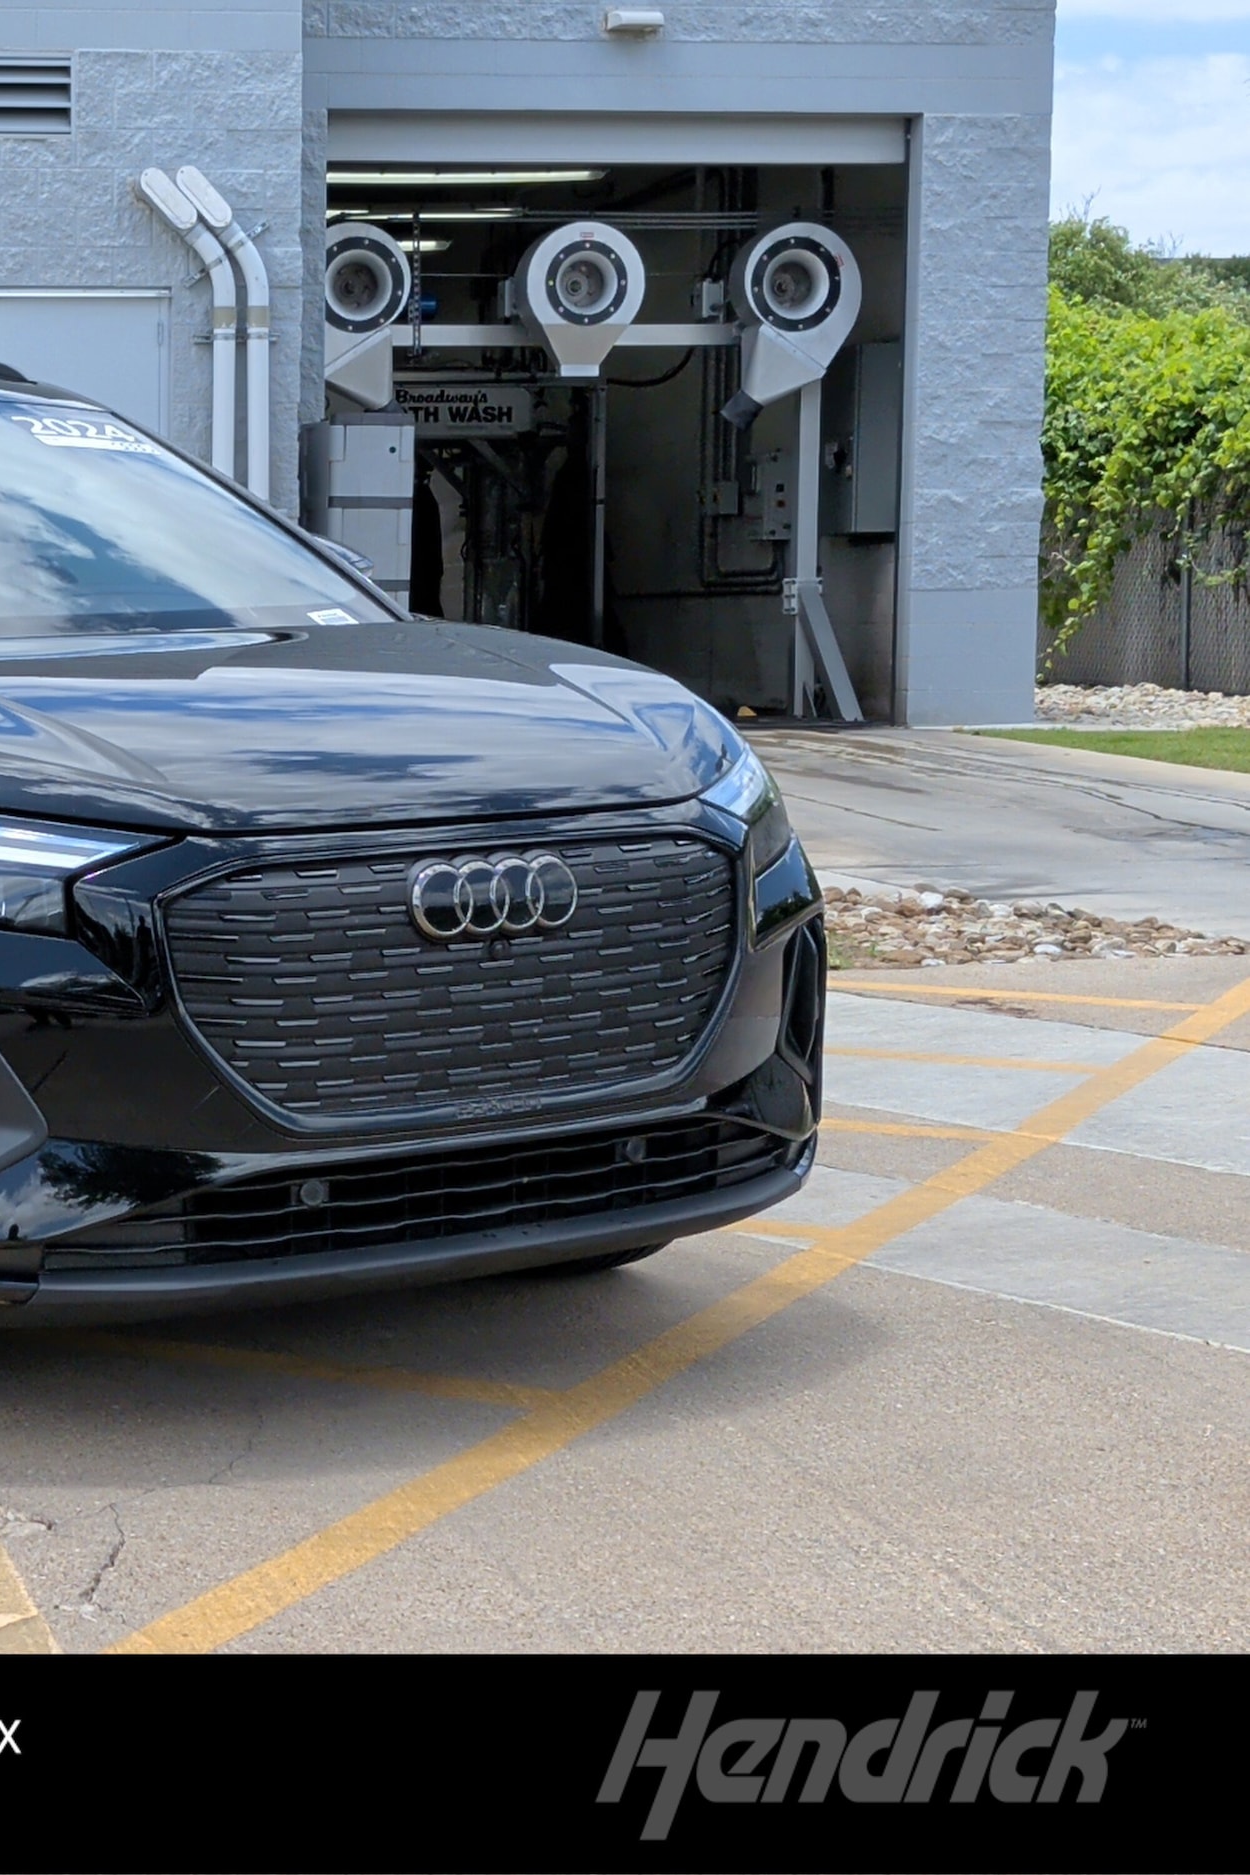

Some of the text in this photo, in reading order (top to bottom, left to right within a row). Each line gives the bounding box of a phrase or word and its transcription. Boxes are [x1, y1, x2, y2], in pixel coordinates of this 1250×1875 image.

[395, 388, 488, 408] Broadway's
[402, 405, 513, 423] TH WASH
[10, 416, 136, 442] 2024
